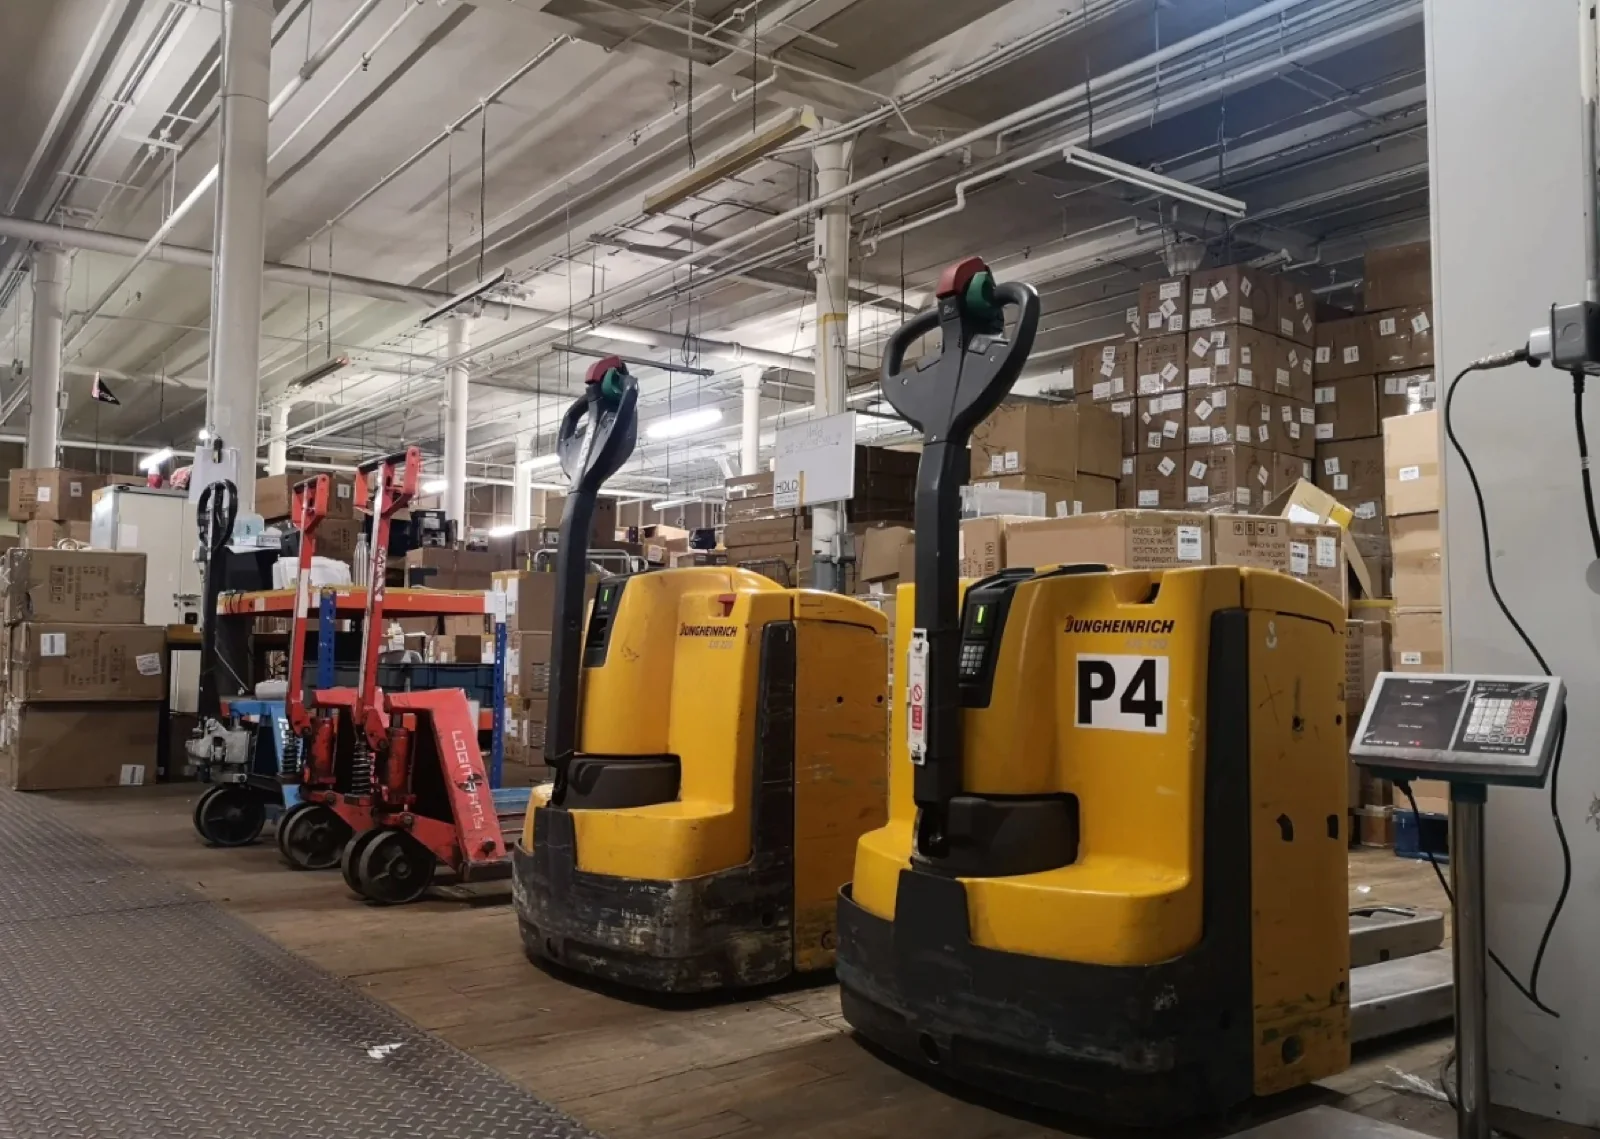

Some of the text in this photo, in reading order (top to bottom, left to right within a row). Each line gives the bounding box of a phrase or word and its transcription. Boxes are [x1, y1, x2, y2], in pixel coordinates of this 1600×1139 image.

[776, 480, 799, 493] HOLD
[680, 622, 738, 637] JUNGHEINRICH
[1064, 615, 1175, 633] JUNGHEINRICH
[1078, 659, 1163, 727] P4
